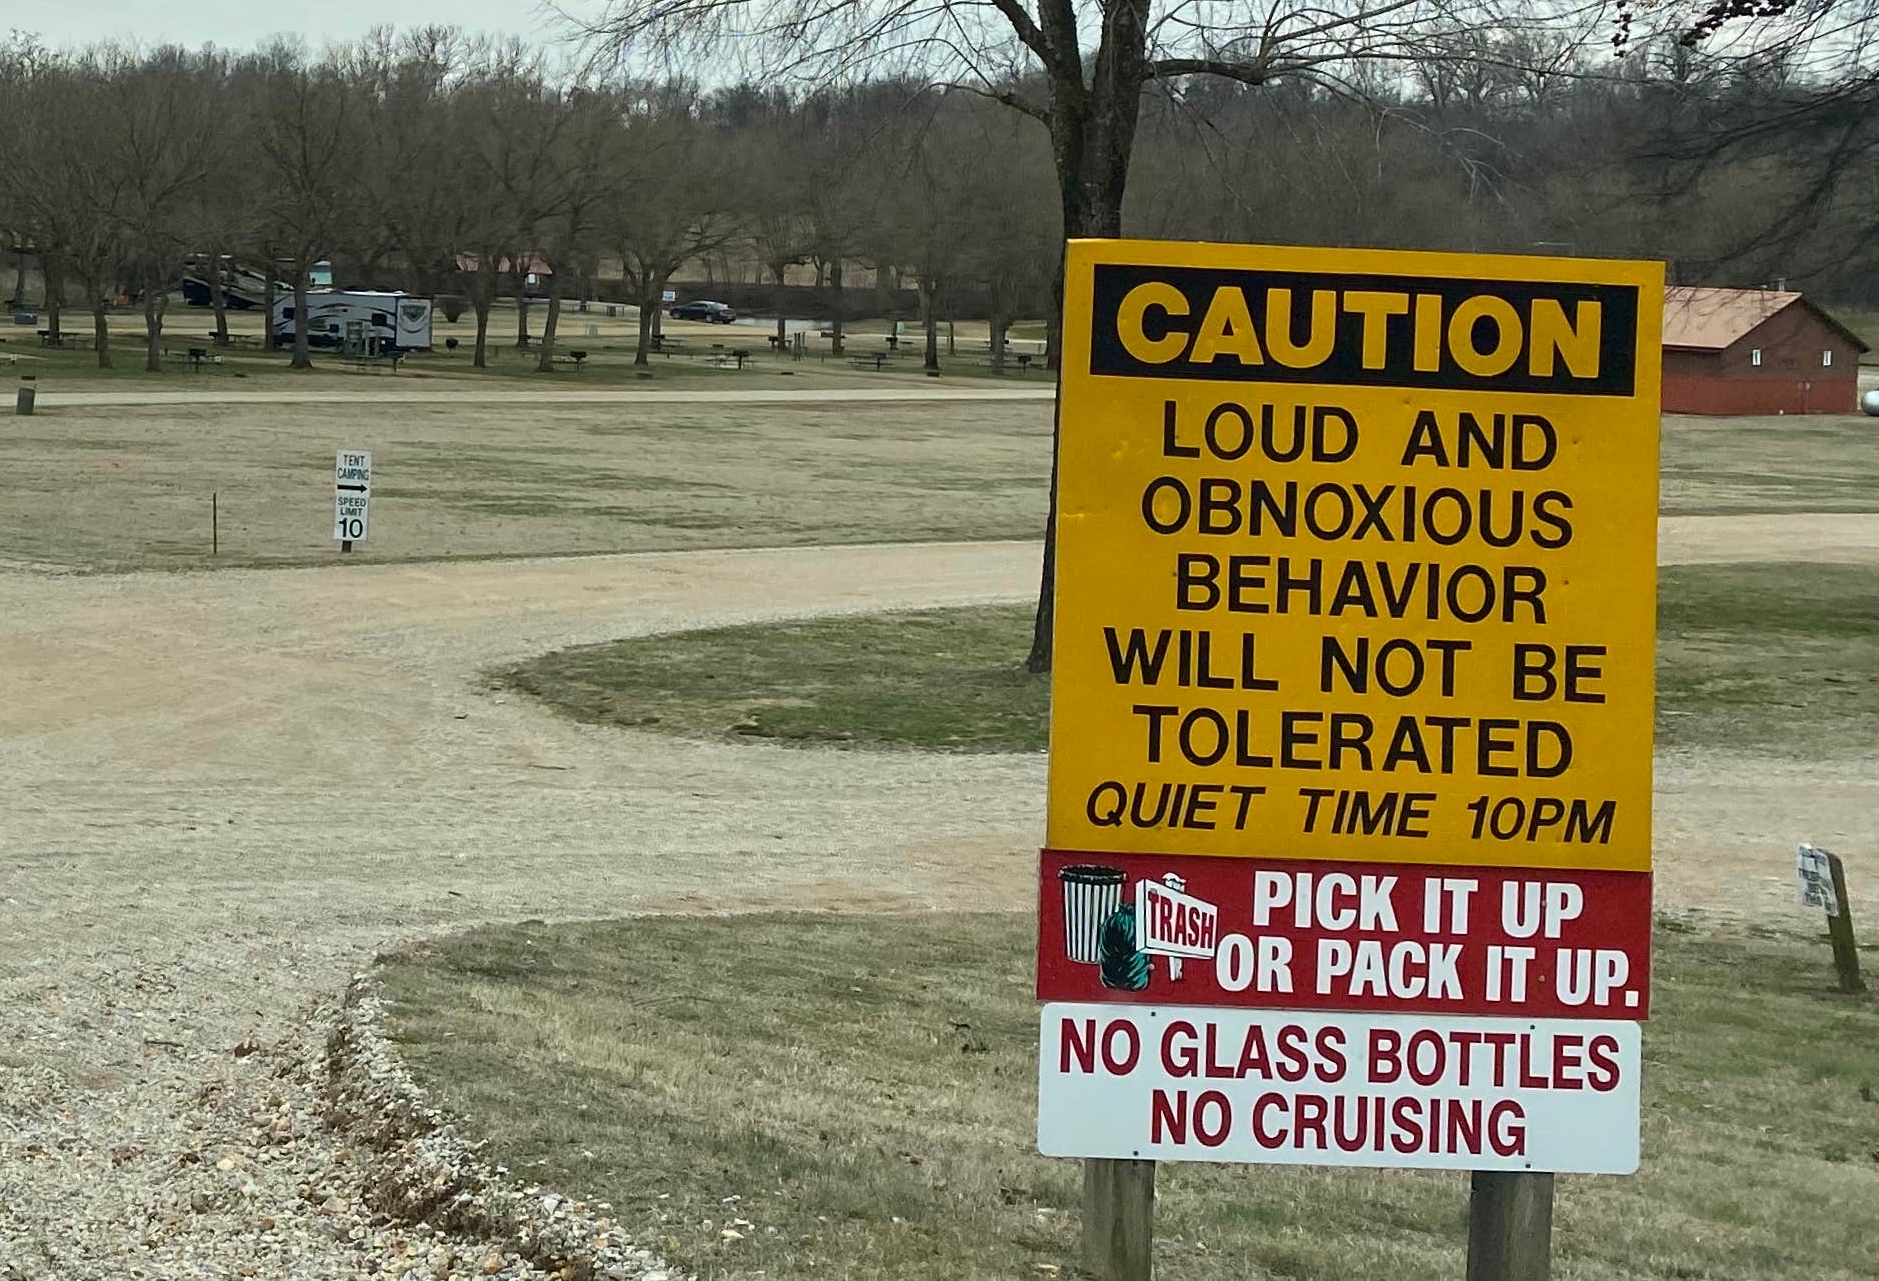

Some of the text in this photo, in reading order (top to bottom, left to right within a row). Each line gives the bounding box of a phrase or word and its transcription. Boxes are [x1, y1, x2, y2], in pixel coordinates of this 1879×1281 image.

[1116, 281, 1601, 379] CAUTION
[343, 454, 365, 466] TENT
[1161, 400, 1559, 471] LOUD AND
[337, 468, 369, 480] CAMPING
[338, 497, 366, 507] SPEED
[339, 518, 363, 538] 10
[341, 507, 363, 516] LIMIT
[1141, 476, 1574, 549] OBNOXIOUS
[1176, 553, 1548, 624] BEHAVIOR
[1103, 627, 1607, 704] WILL NOT BE
[1132, 704, 1573, 779] TOLERATED
[1086, 781, 1617, 844] QUIET TIME 10PM
[1146, 890, 1215, 951] TRASH
[1252, 871, 1584, 939] PICK IT UP
[1216, 934, 1640, 1008] OR PACK IT UP.
[1060, 1019, 1621, 1092] NO GLASS BOTTLES
[1150, 1090, 1527, 1156] NO CRUISING
